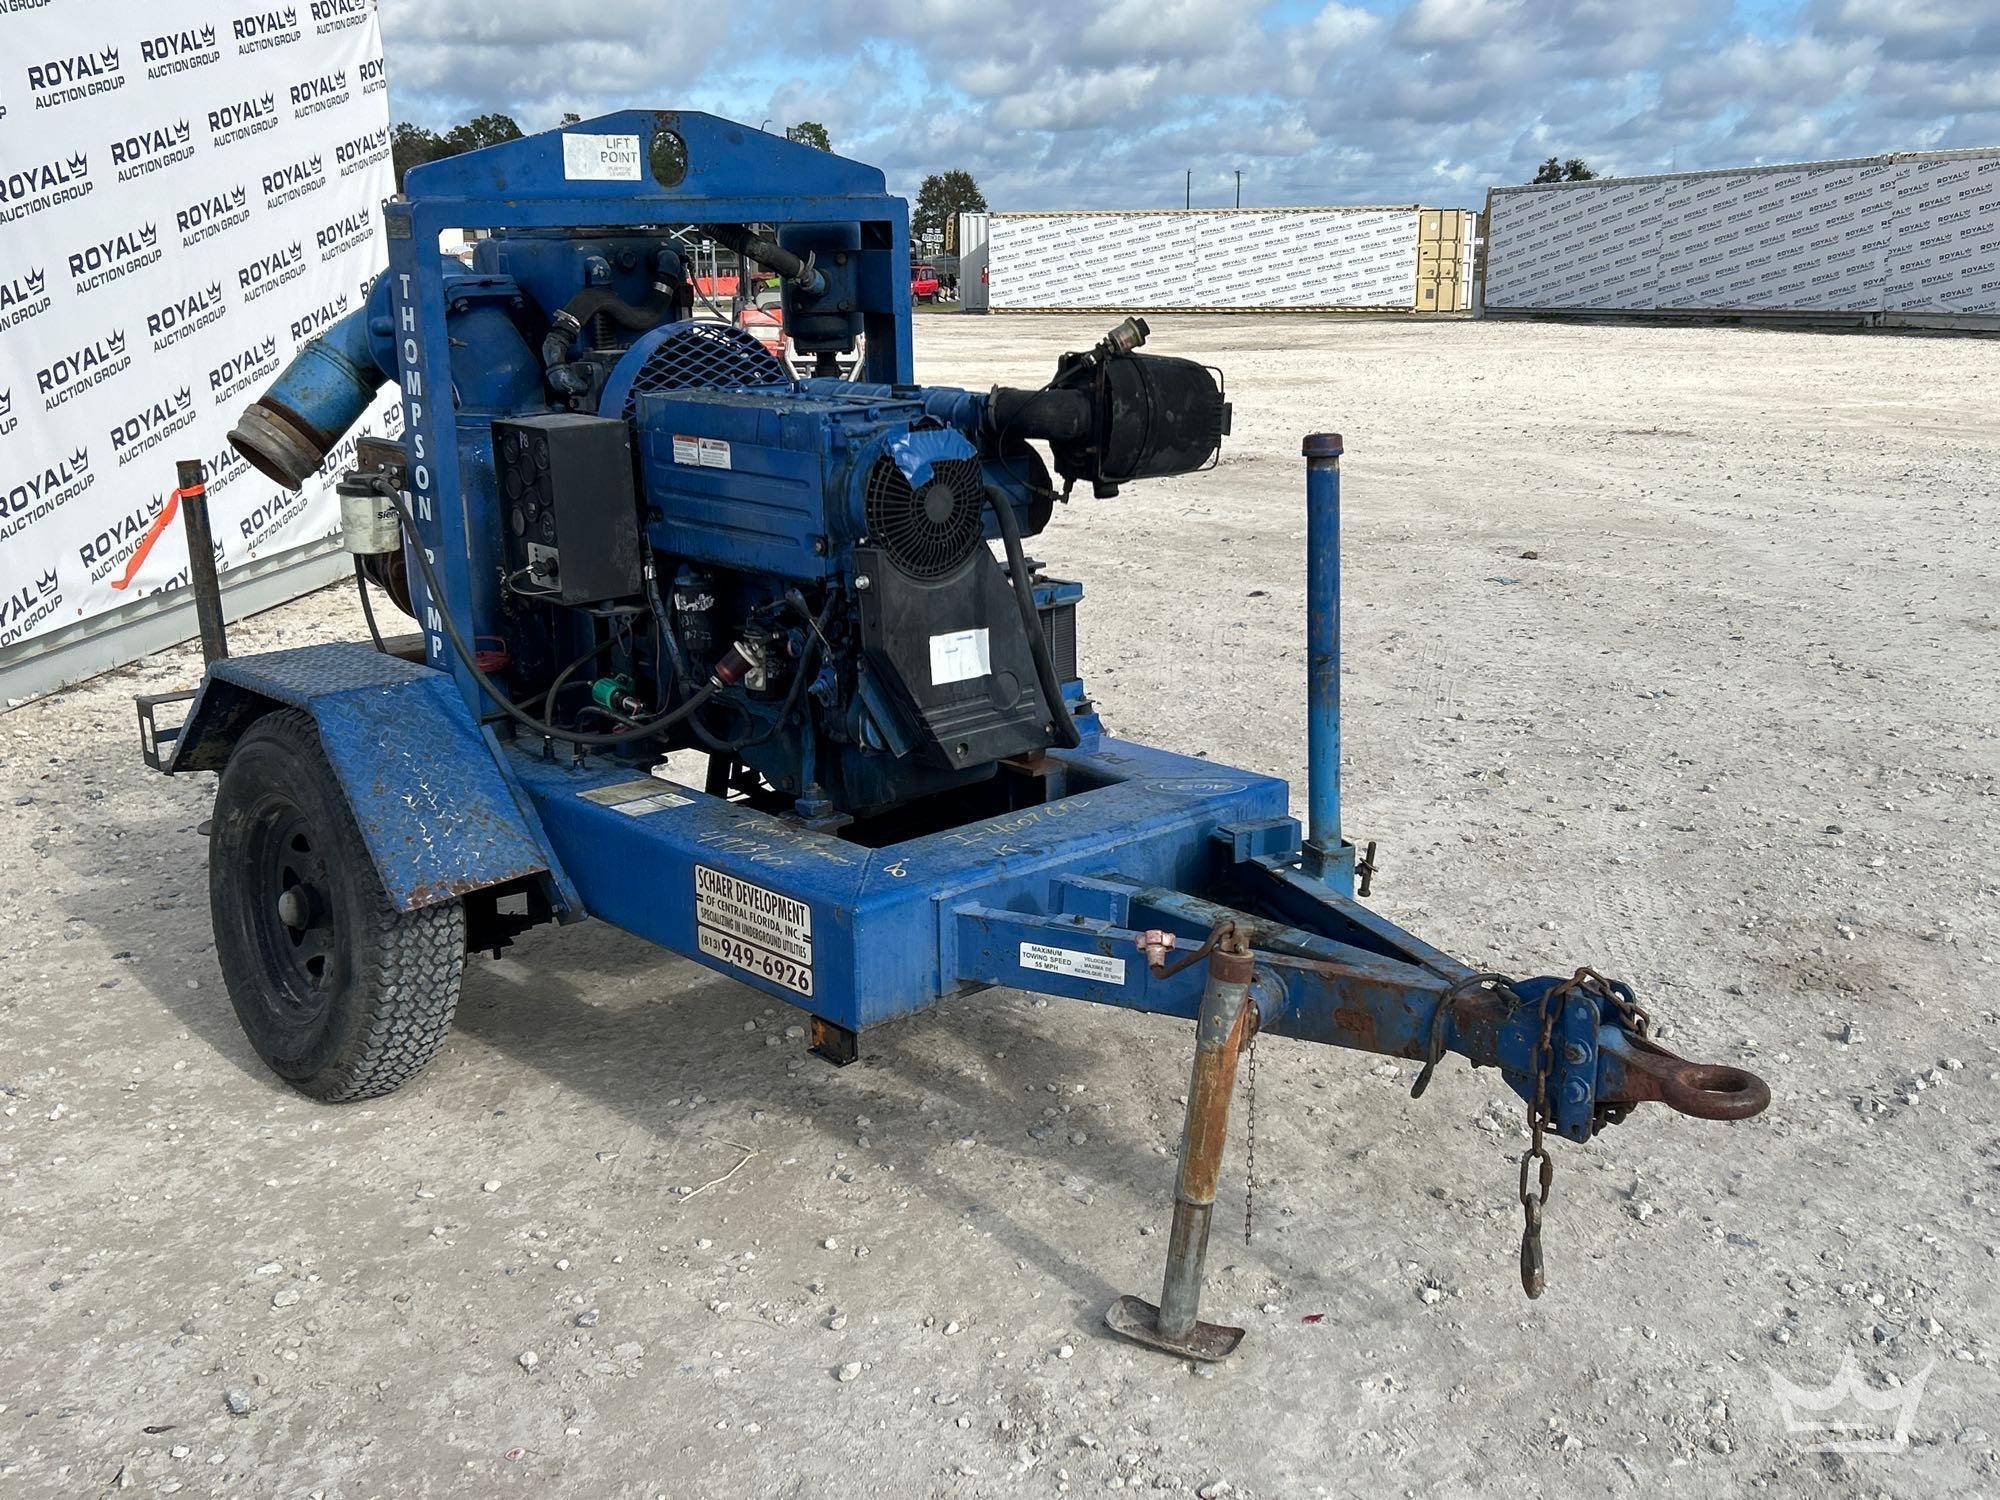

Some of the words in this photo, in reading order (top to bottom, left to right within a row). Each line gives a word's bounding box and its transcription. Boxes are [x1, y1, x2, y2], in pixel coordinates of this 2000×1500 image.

[310, 0, 356, 21] ROYAL
[233, 11, 286, 40] ROYAL
[316, 20, 346, 36] AUCTION
[346, 13, 368, 28] GROUP
[140, 29, 203, 63] ROYAL
[238, 37, 274, 56] AUCTION
[274, 30, 302, 46] GROUP
[28, 54, 104, 91] ROYAL
[147, 58, 190, 80] AUCTION
[189, 51, 221, 71] GROUP
[35, 86, 87, 110] AUCTION
[88, 75, 126, 96] GROUP
[290, 75, 337, 105] ROYAL
[208, 98, 263, 133] ROYAL
[294, 101, 326, 120] AUCTION
[326, 92, 350, 109] GROUP
[213, 127, 251, 148] AUCTION
[251, 117, 279, 135] GROUP
[606, 138, 630, 149] LIFT
[111, 127, 177, 166] ROYAL
[335, 133, 378, 165] ROYAL
[601, 152, 638, 163] POINT
[118, 158, 163, 183] AUCTION
[163, 146, 195, 167] GROUP
[340, 159, 369, 178] AUCTION
[368, 148, 390, 166] GROUP
[1860, 165, 1882, 177] ROYAL
[262, 160, 312, 195] ROYAL
[1774, 178, 1795, 188] ROYAL
[1824, 177, 1847, 189] ROYAL
[1897, 183, 1923, 196] ROYAL
[1937, 172, 1963, 184] ROYAL
[1959, 185, 1985, 197] ROYAL
[0, 195, 51, 225] AUCTION
[52, 181, 93, 206] GROUP
[267, 189, 300, 210] AUCTION
[300, 176, 326, 196] GROUP
[1790, 190, 1812, 200] ROYAL
[1809, 201, 1831, 212] ROYAL
[1844, 190, 1867, 201] ROYAL
[1919, 197, 1945, 209] ROYAL
[176, 193, 234, 233] ROYAL
[1775, 212, 1797, 223] ROYAL
[1826, 214, 1848, 225] ROYAL
[1861, 202, 1884, 214] ROYAL
[1937, 210, 1964, 223] ROYAL
[182, 223, 221, 249] AUCTION
[221, 209, 250, 231] GROUP
[316, 214, 361, 249] ROYAL
[1791, 225, 1813, 236] ROYAL
[1845, 226, 1868, 237] ROYAL
[1899, 221, 1923, 233] ROYAL
[1960, 224, 1986, 236] ROYAL
[321, 242, 351, 264] AUCTION
[351, 228, 374, 247] GROUP
[1776, 247, 1799, 257] ROYAL
[1810, 237, 1833, 248] ROYAL
[1862, 239, 1886, 250] ROYAL
[1920, 236, 1945, 247] ROYAL
[68, 233, 142, 278] ROYAL
[238, 249, 291, 289] ROYAL
[1793, 260, 1815, 270] ROYAL
[1827, 250, 1850, 261] ROYAL
[1846, 263, 1868, 273] ROYAL
[1900, 260, 1924, 270] ROYAL
[1939, 250, 1964, 261] ROYAL
[1961, 264, 1988, 274] ROYAL
[76, 264, 126, 296] AUCTION
[126, 249, 162, 273] GROUP
[244, 279, 279, 304] AUCTION
[279, 264, 307, 285] GROUP
[1811, 273, 1834, 283] ROYAL
[1921, 273, 1947, 284] ROYAL
[1778, 281, 1800, 292] ROYAL
[1828, 286, 1851, 296] ROYAL
[1883, 283, 1907, 293] ROYAL
[1940, 288, 1966, 299] ROYAL
[11, 297, 51, 325] GROUP
[147, 290, 209, 337] ROYAL
[1901, 298, 1926, 308] ROYAL
[1962, 303, 1988, 312] ROYAL
[153, 317, 196, 353] AUCTION
[196, 305, 226, 330] GROUP
[290, 301, 338, 342] ROYAL
[36, 341, 110, 395] ROYAL
[209, 345, 265, 392] ROYAL
[45, 376, 94, 412] AUCTION
[94, 355, 132, 383] GROUP
[215, 377, 252, 406] AUCTION
[251, 358, 280, 382] GROUP
[399, 273, 432, 522] THOMPSON
[110, 398, 177, 451] ROYAL
[119, 430, 163, 468] AUCTION
[163, 410, 197, 439] GROUP
[0, 499, 54, 542] AUCTION
[56, 473, 95, 506] GROUP
[239, 489, 293, 540] ROYAL
[79, 509, 149, 568] ROYAL
[247, 521, 283, 553] AUCTION
[283, 498, 308, 526] GROUP
[90, 543, 135, 585] AUCTION
[24, 594, 62, 633] GROUP
[698, 868, 733, 900] SCHAER
[736, 882, 805, 927] DEVELOPMENT
[706, 895, 715, 907] OF
[717, 898, 748, 920] CENTRAL
[749, 912, 783, 935] FLORIDA,
[785, 925, 800, 941] INC.
[701, 907, 734, 930] SPECIALIZING
[735, 920, 741, 932] IN
[741, 923, 781, 949] UNDERGROUND
[782, 938, 807, 959] UTILITIES
[701, 934, 721, 952] (813)
[721, 938, 809, 991] 949-6926
[1022, 952, 1048, 962] TOWING
[1050, 956, 1072, 966] SPEED
[1031, 946, 1063, 957] MAXIMUM
[1084, 956, 1113, 966] VELOCIDAD
[1035, 961, 1042, 969] 55
[1044, 963, 1059, 971] MPH
